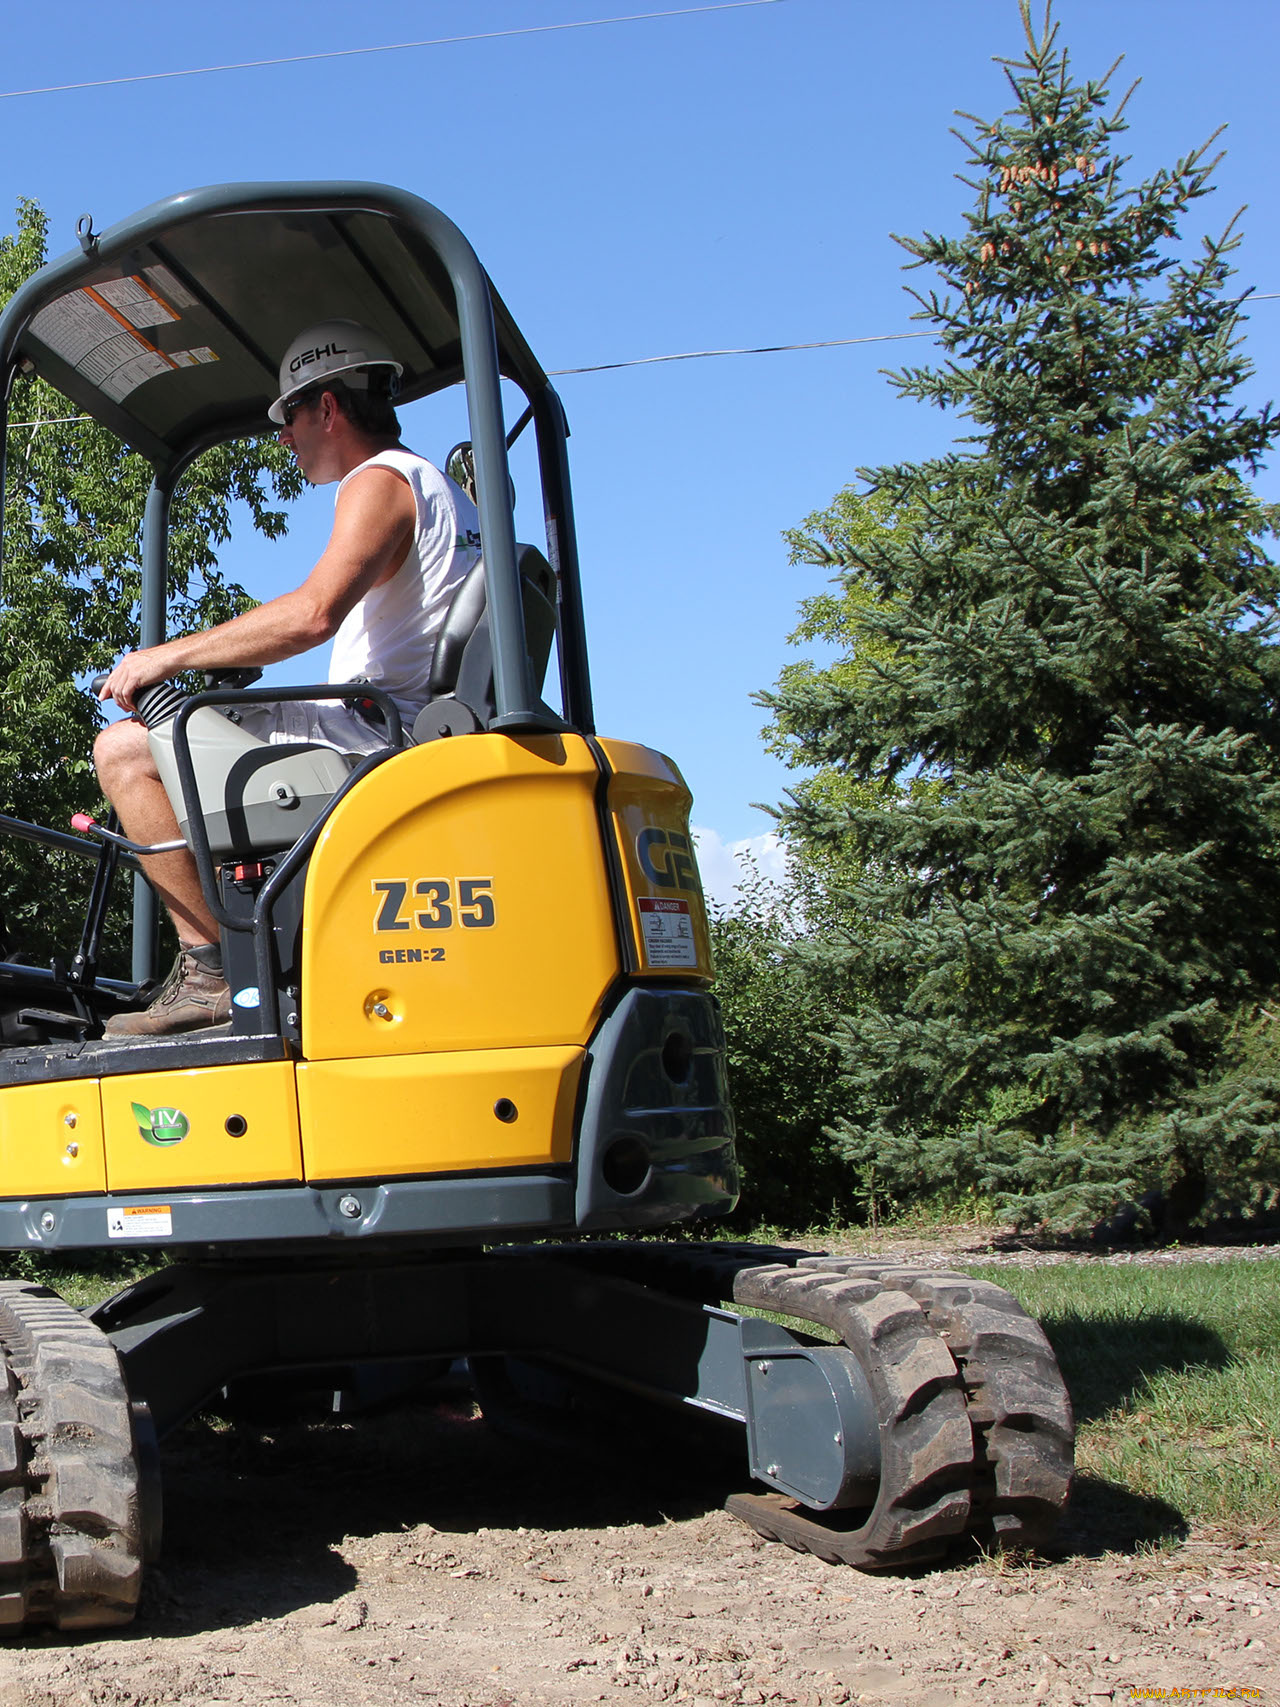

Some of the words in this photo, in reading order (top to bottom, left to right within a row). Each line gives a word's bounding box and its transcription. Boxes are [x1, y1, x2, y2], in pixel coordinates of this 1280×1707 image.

[289, 342, 348, 373] GEHL
[373, 877, 496, 932] Z35
[378, 947, 447, 965] GEN:2
